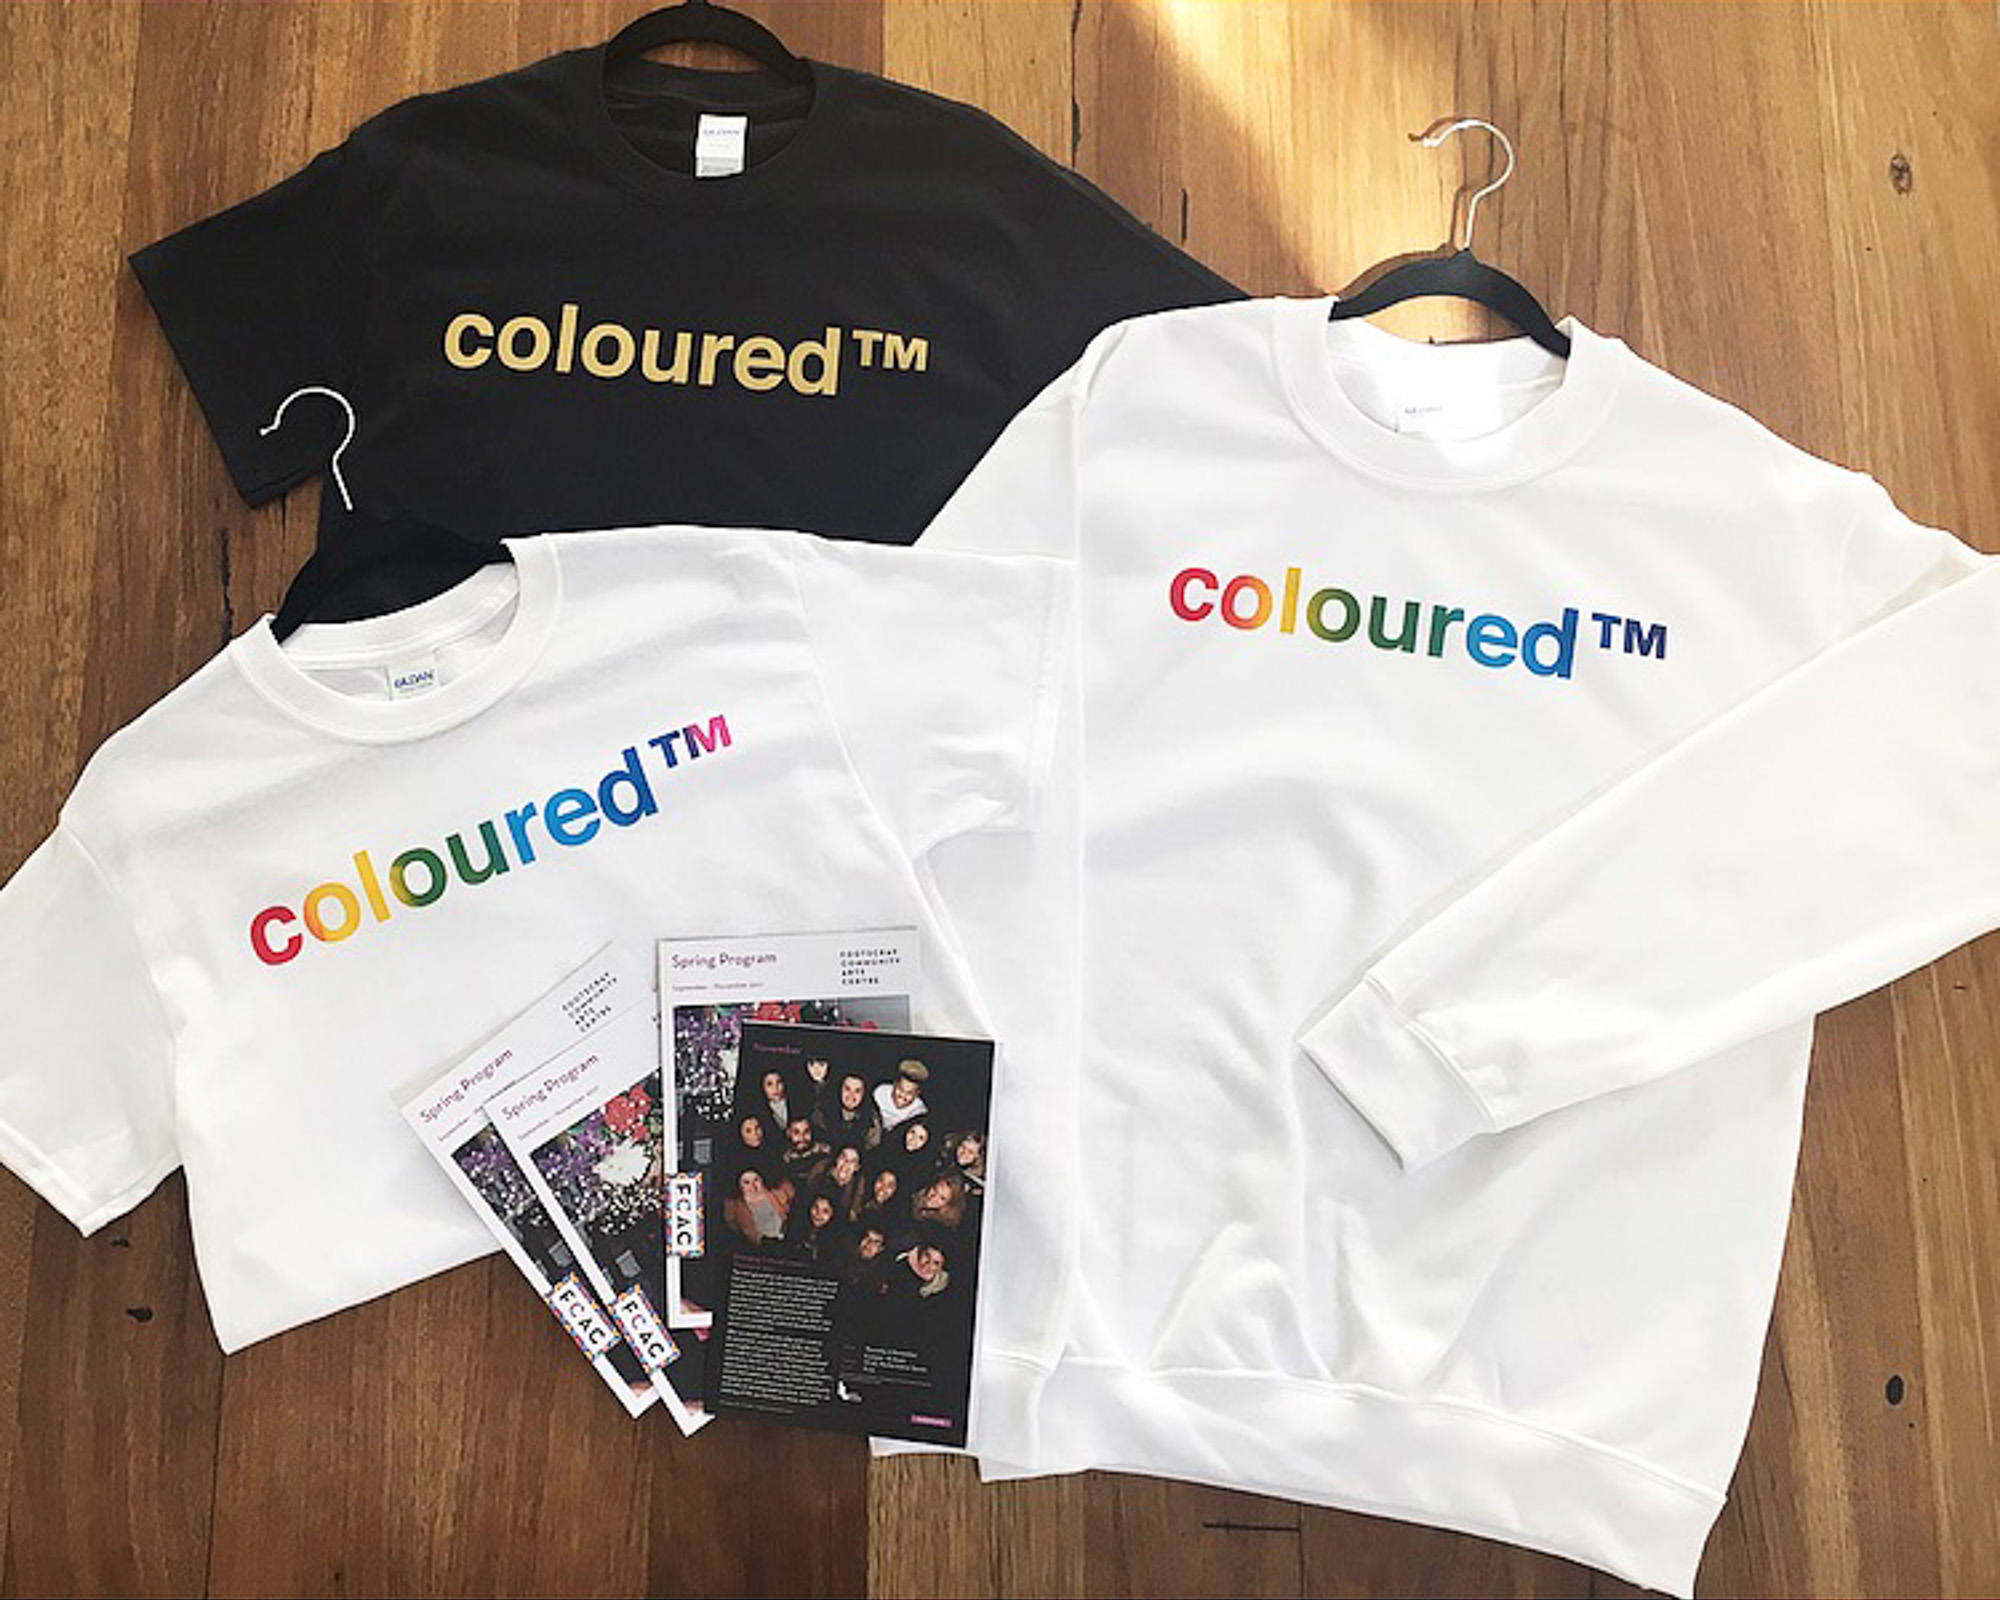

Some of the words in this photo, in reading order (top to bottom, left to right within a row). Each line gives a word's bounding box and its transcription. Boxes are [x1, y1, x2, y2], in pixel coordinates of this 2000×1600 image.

[671, 953, 716, 970] Spring
[719, 951, 777, 969] Program
[420, 1088, 465, 1123] Spring
[459, 1049, 513, 1091] Program
[501, 1088, 548, 1121] Spring
[543, 1054, 599, 1092] Program
[677, 1183, 693, 1246] FCAC
[559, 1289, 606, 1346] FCAC
[621, 1299, 665, 1359] FCAC
